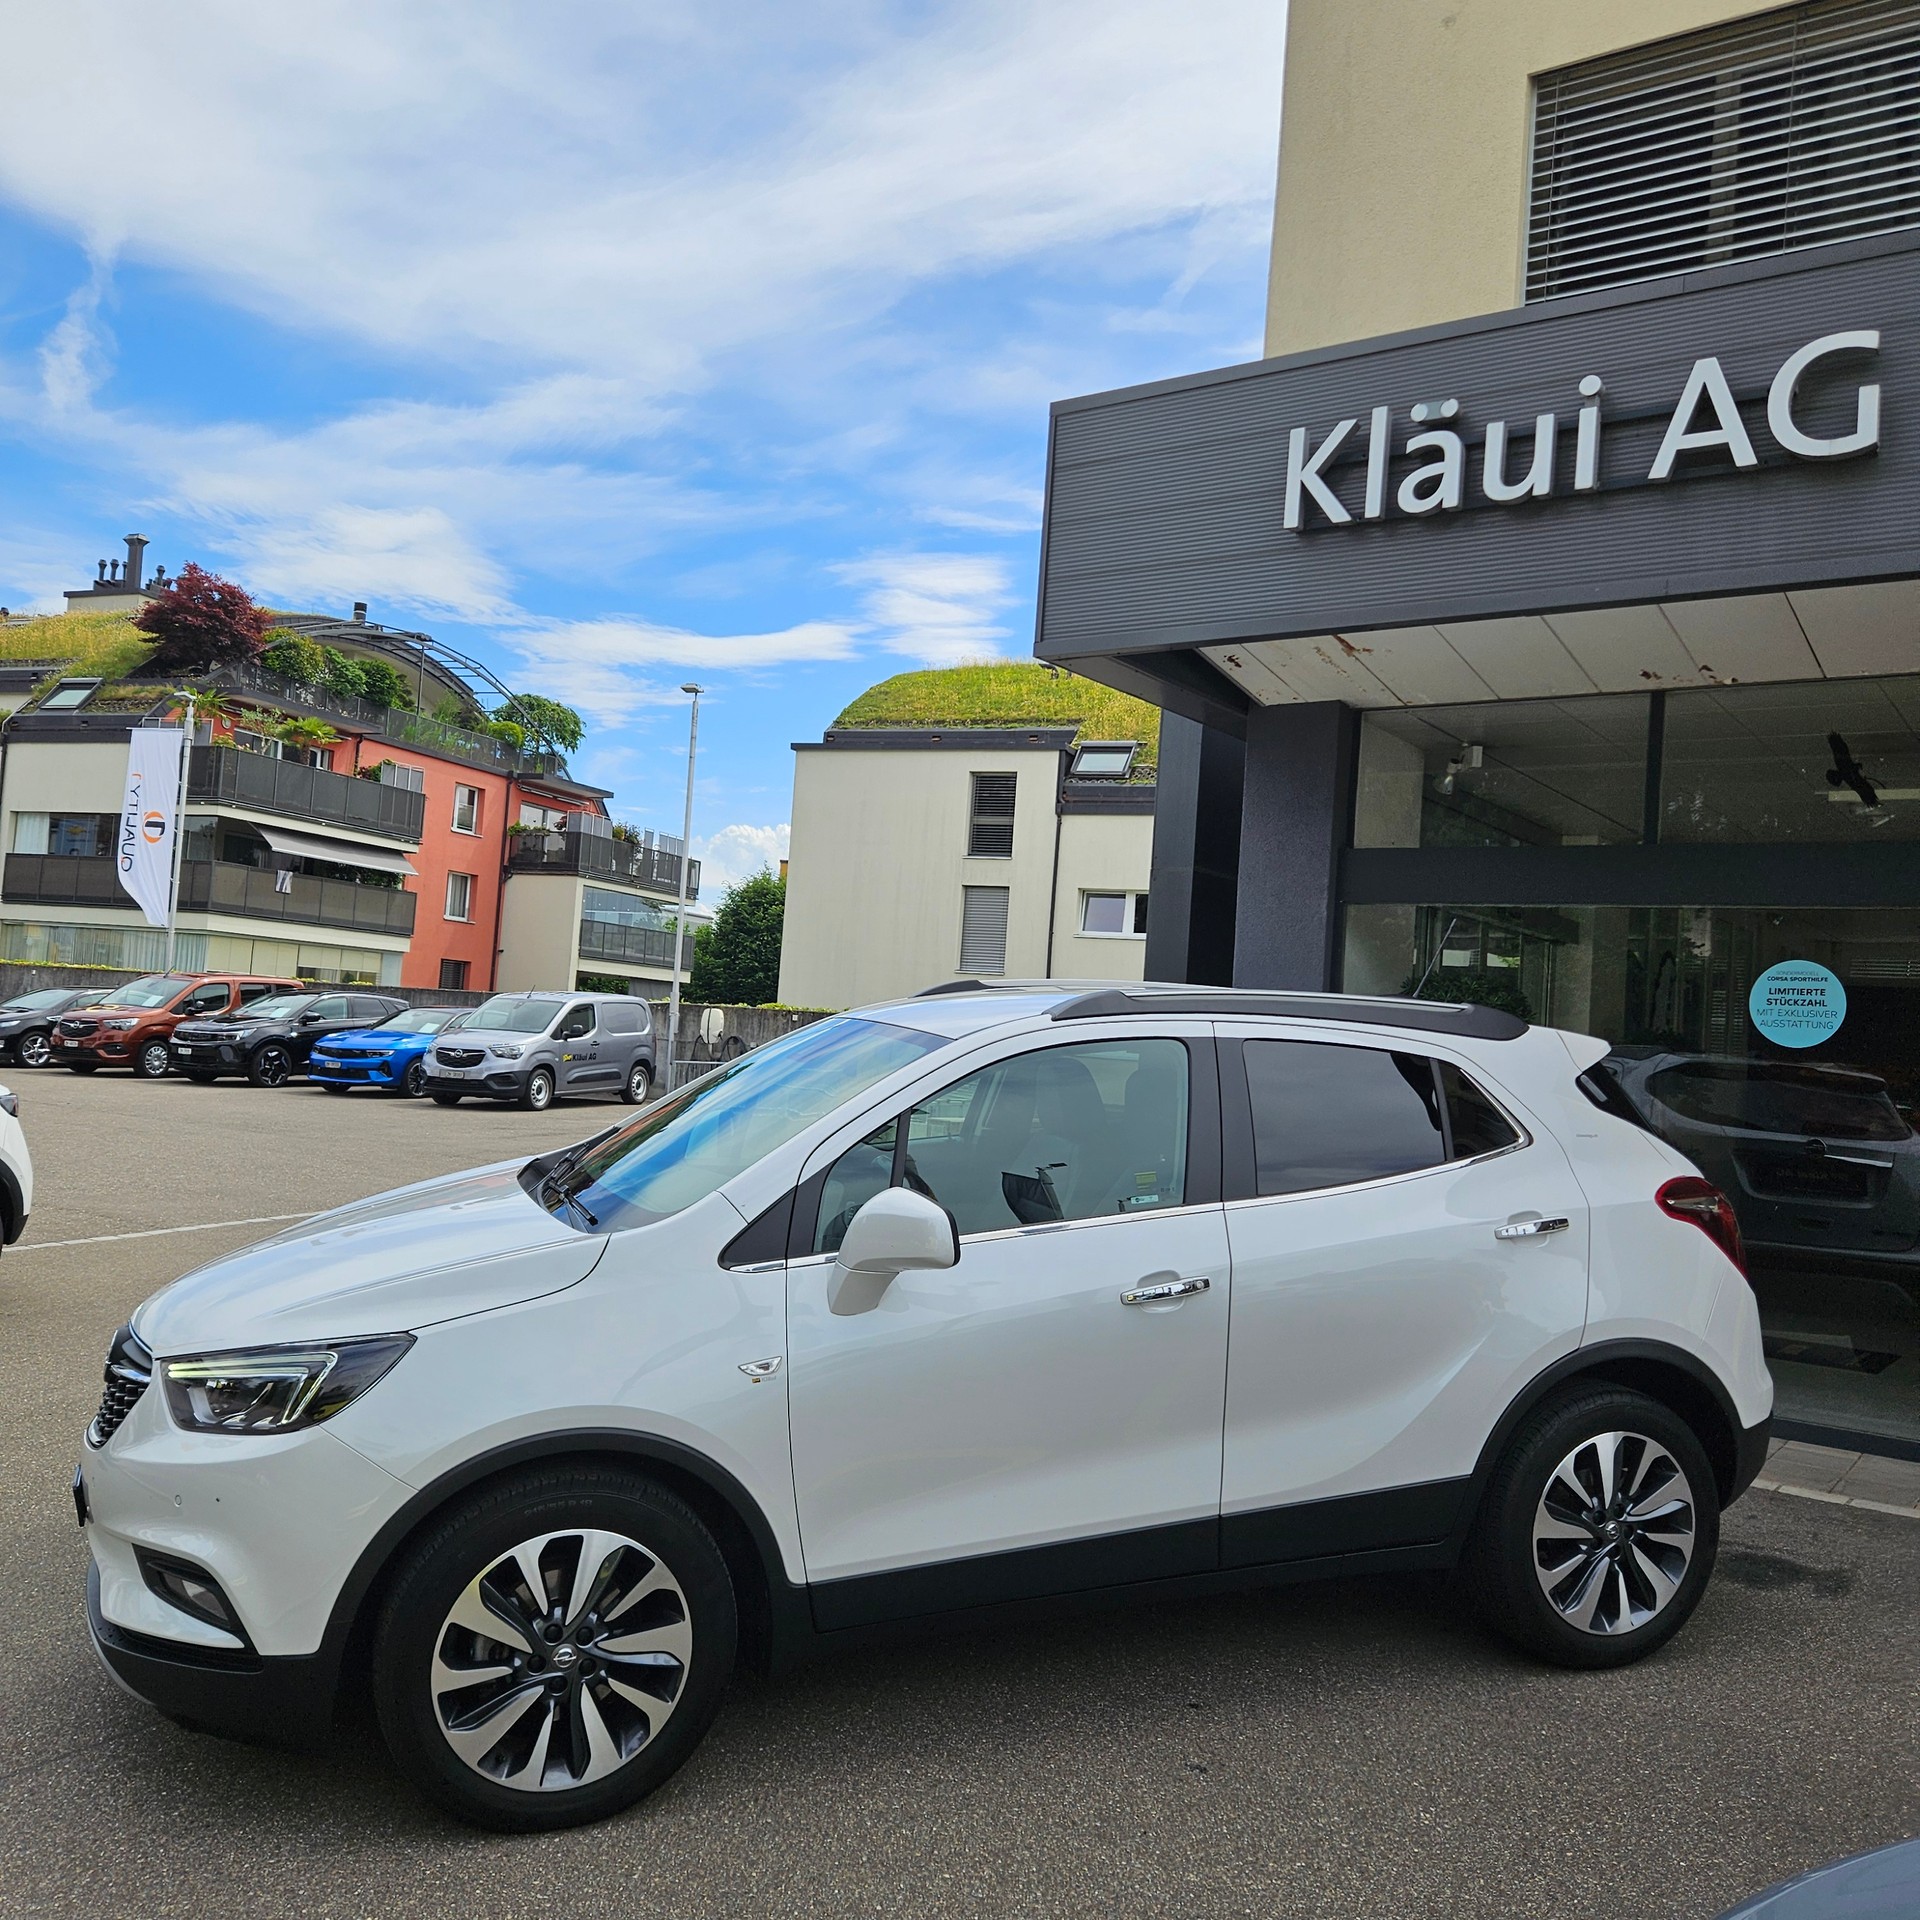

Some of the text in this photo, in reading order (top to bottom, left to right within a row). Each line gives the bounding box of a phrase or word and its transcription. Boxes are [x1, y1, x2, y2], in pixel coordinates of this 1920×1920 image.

[1283, 330, 1881, 532] Kläui AG
[1768, 988, 1826, 996] LIMITIERTE
[1766, 996, 1827, 1007] STÜCKZAHL
[1756, 1008, 1838, 1019] MIT EXKLUSIVER
[1760, 1019, 1834, 1030] AUSSTATTUNG
